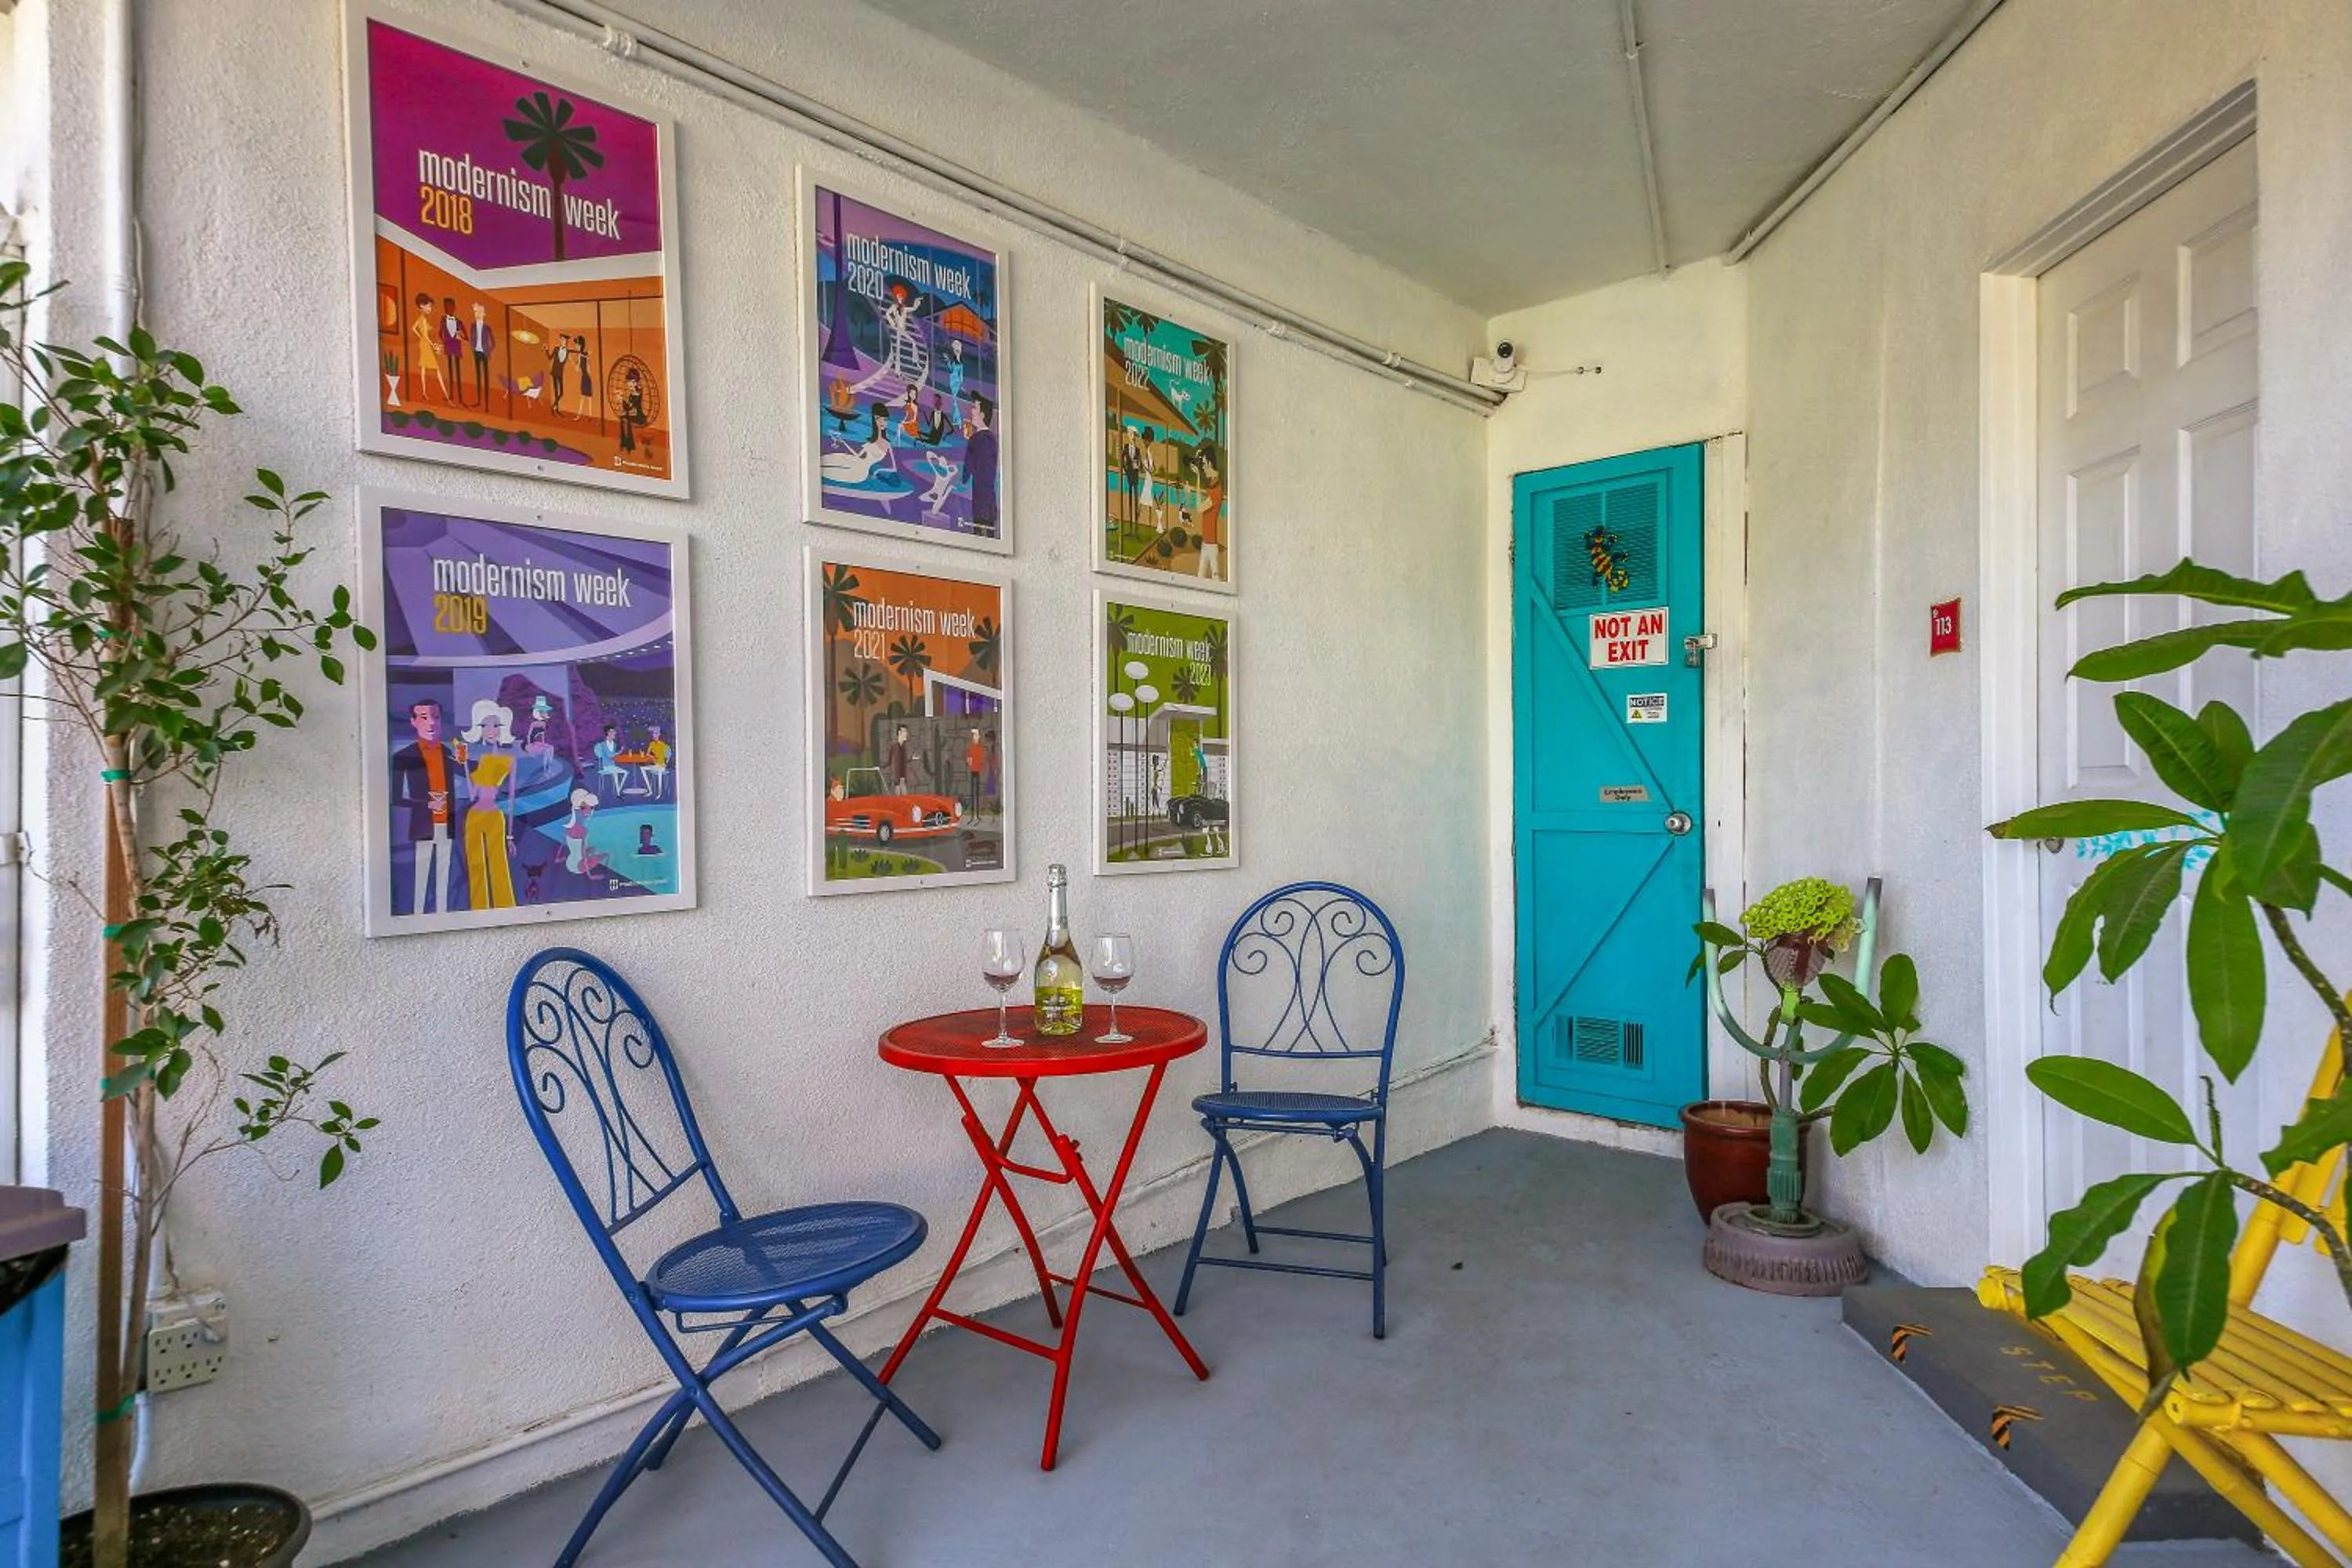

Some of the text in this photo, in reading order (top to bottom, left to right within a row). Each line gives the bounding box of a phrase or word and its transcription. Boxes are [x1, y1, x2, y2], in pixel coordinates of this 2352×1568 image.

[419, 149, 621, 240] modernism week
[419, 186, 474, 234] 2018
[847, 233, 971, 300] modernism week
[848, 261, 884, 300] 2020
[1123, 336, 1210, 386] modernism week
[1125, 360, 1149, 390] 2022
[434, 554, 630, 607] modernism week
[434, 593, 488, 634] 2019
[853, 597, 975, 638] modernism week
[1595, 614, 1663, 639] NOT AN
[1935, 615, 1951, 636] 113
[854, 629, 886, 660] 2021
[1127, 629, 1211, 662] modernism week
[1608, 639, 1649, 662] EXIT
[1189, 661, 1210, 685] 2023
[1630, 697, 1664, 706] NOTICE
[1998, 1345, 2098, 1401] STEP
